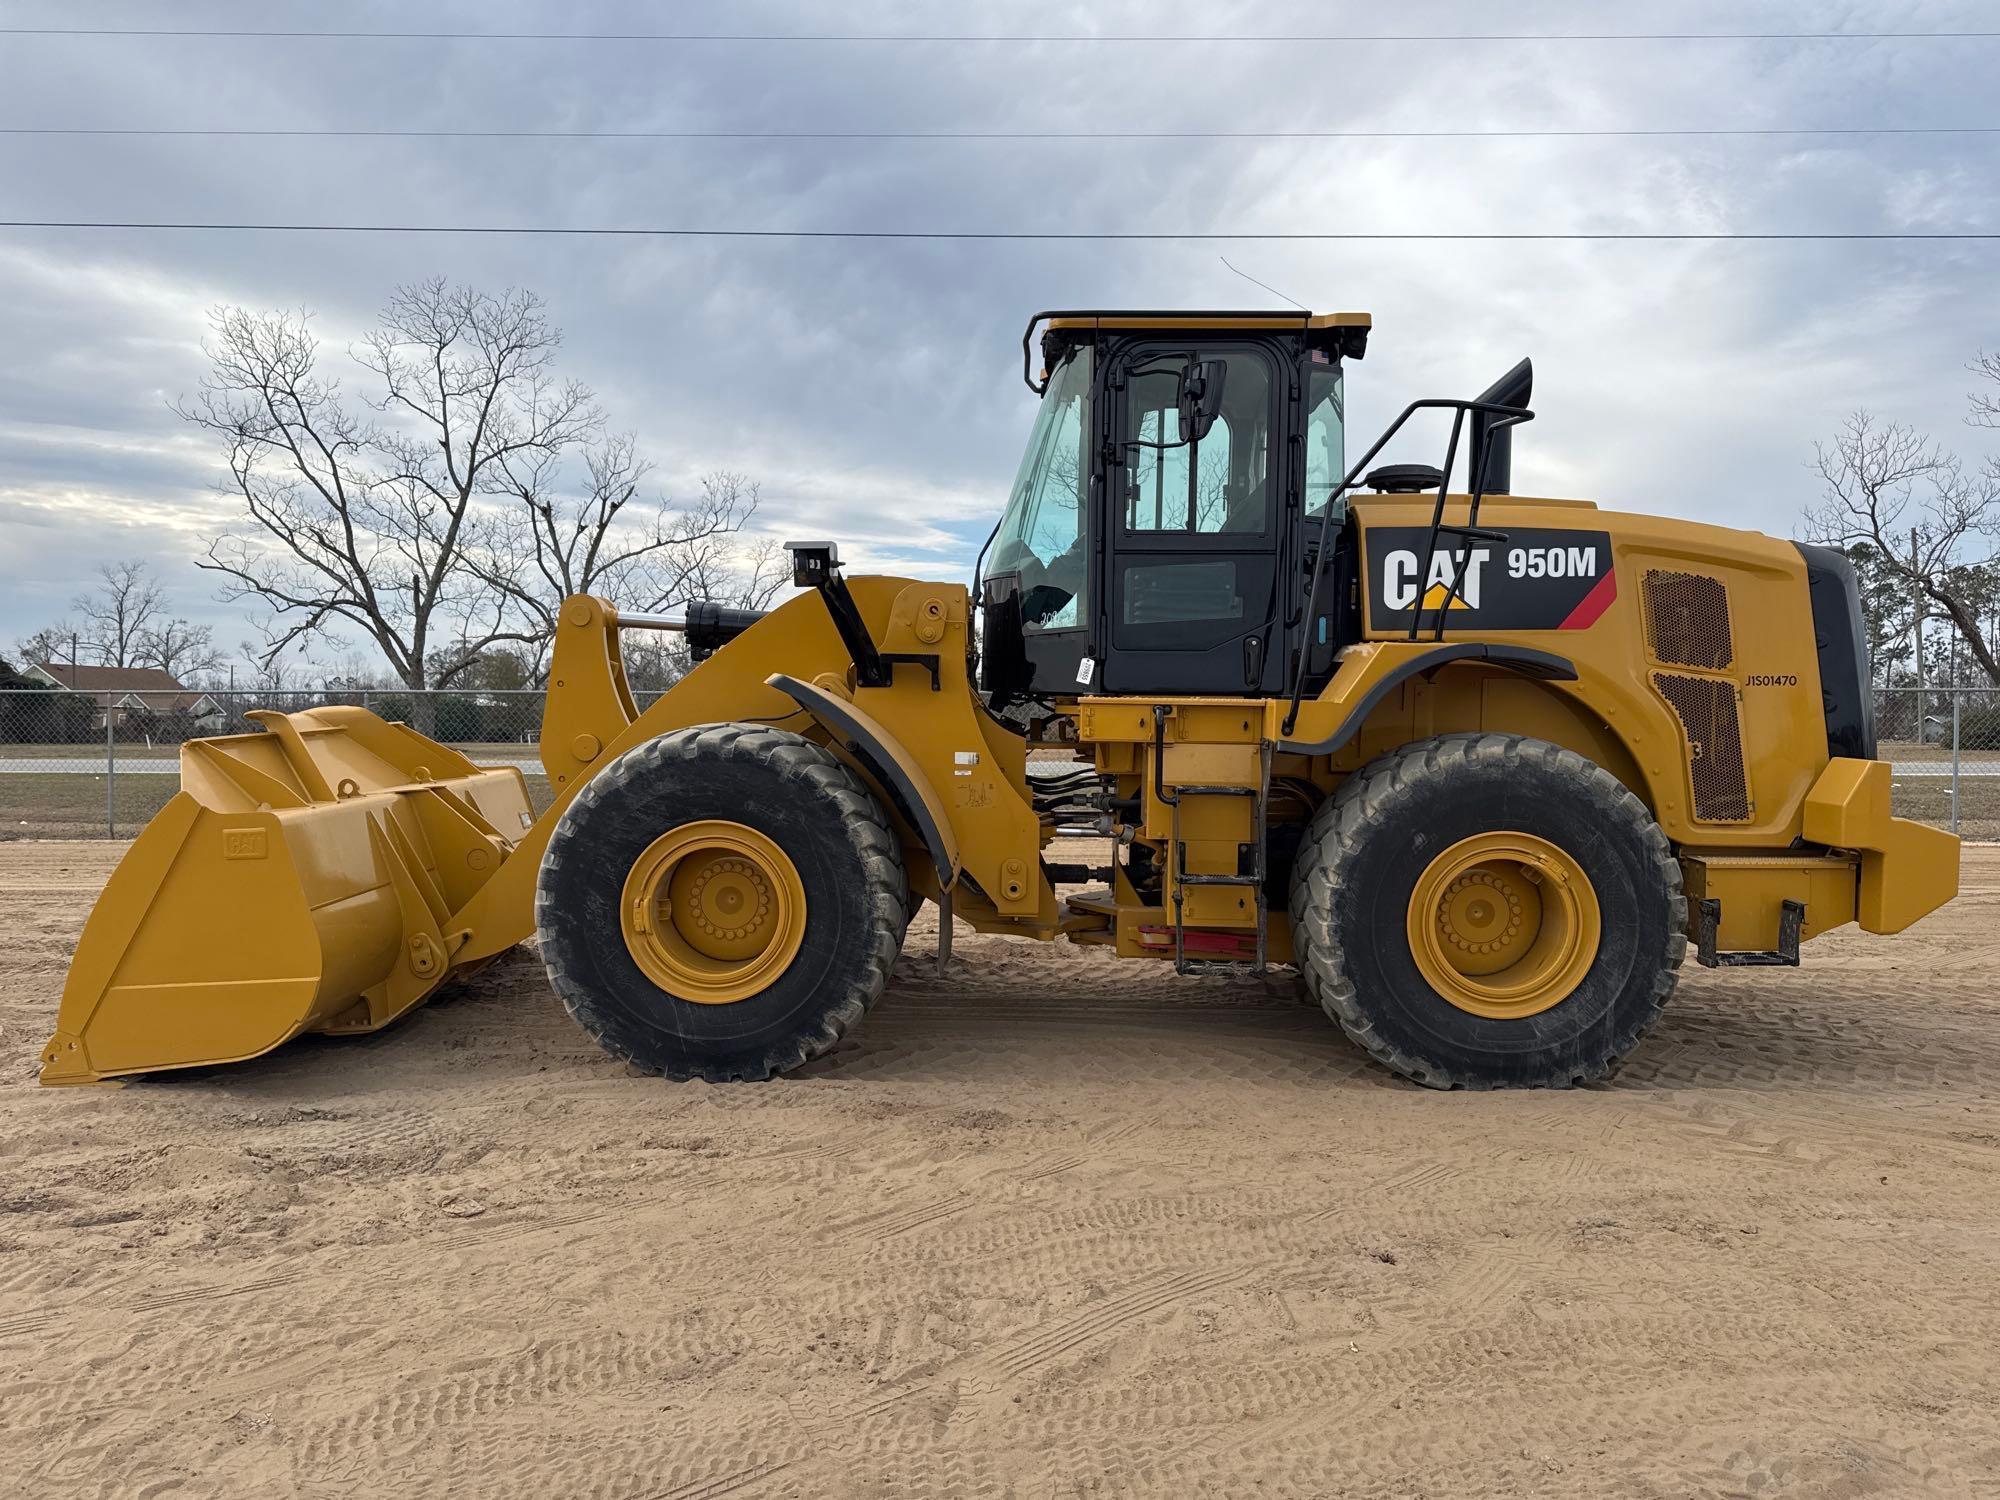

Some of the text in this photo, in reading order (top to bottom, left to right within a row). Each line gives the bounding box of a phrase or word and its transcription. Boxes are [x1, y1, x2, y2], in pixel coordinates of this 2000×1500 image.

[1384, 546, 1596, 611] CAT 950M
[1745, 675, 1797, 686] J1S01470
